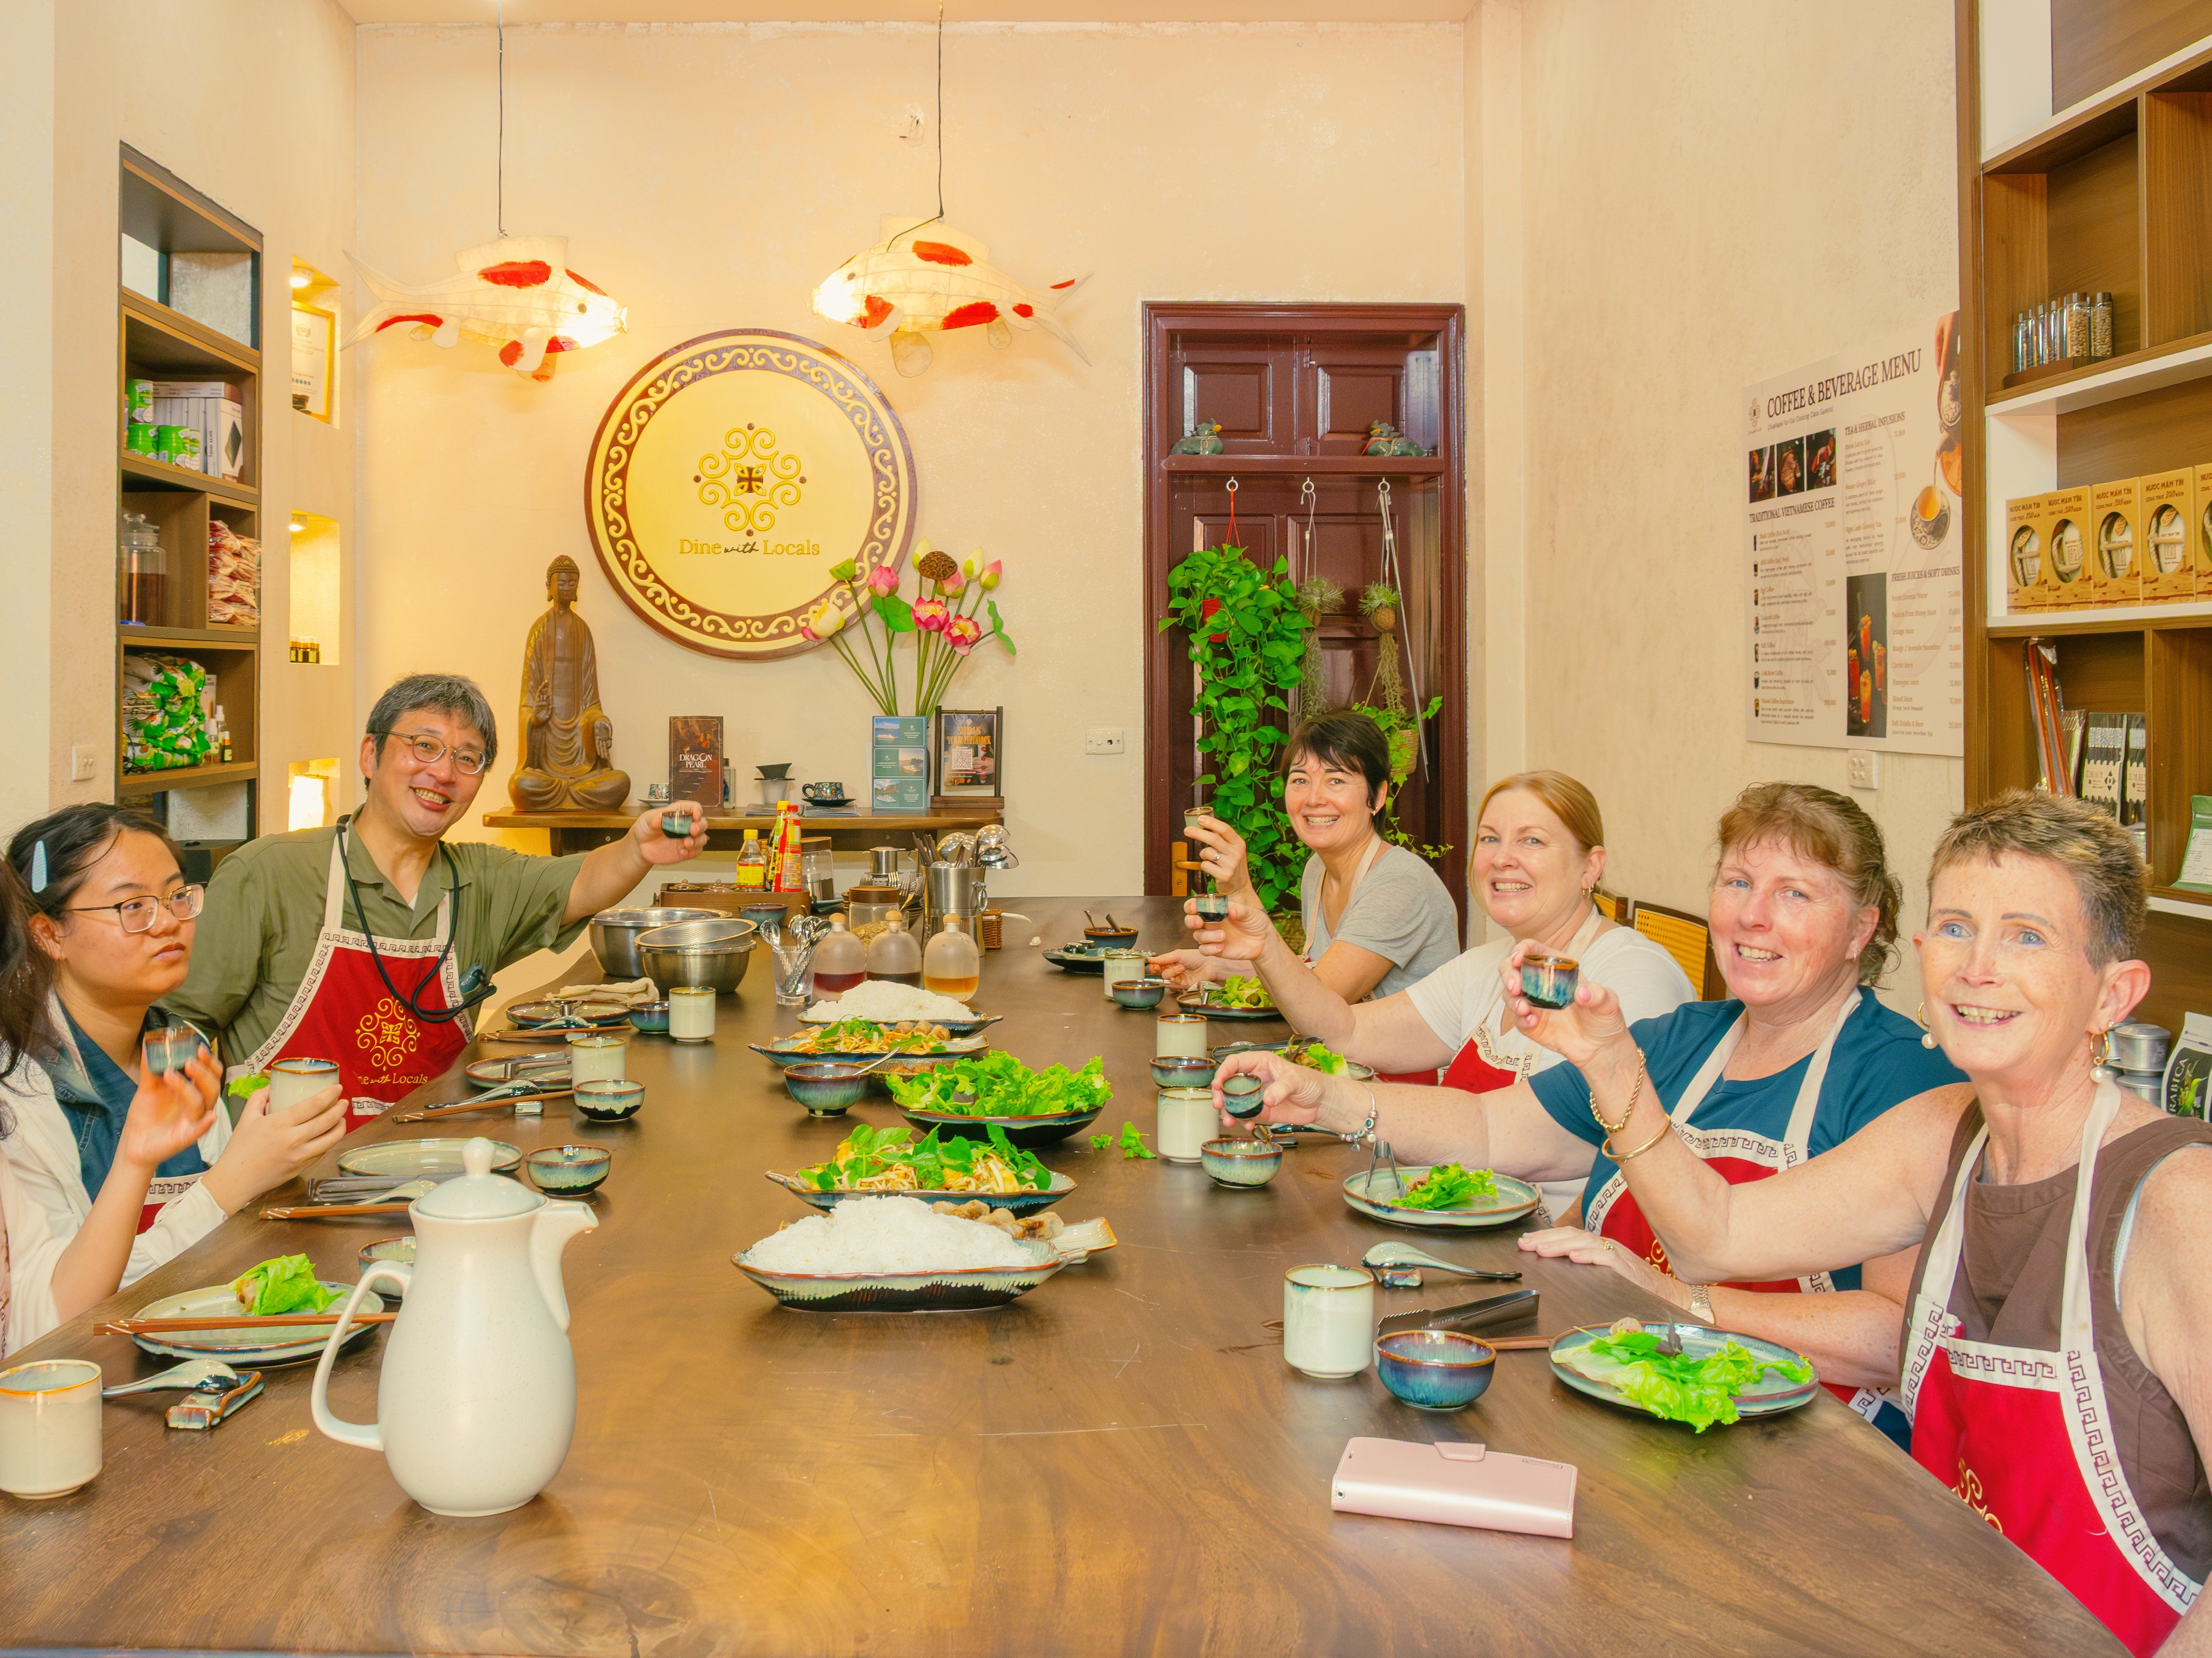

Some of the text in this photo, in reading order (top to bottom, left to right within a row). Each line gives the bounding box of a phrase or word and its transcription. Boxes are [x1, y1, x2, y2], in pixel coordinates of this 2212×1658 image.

[1767, 348, 1921, 418] COFFEE & BEVERAGE MENU
[1844, 426, 1853, 436] TEA
[1859, 420, 1877, 433] HERBAL
[1878, 411, 1906, 427] INFUSIONS
[1749, 508, 1781, 523] TRADITIONAL
[1782, 501, 1814, 517] VIETNAMESE
[1815, 497, 1835, 511] COFFEE
[679, 539, 820, 555] Dine with Locals
[1892, 572, 1906, 582] FRESH
[1907, 570, 1923, 580] JUICES
[1928, 568, 1940, 578] SOFT
[1941, 566, 1960, 576] DRINKS
[679, 753, 712, 762] DRAGON
[358, 1073, 428, 1084] ne with Locals
[2169, 1058, 2189, 1113] RABICA
